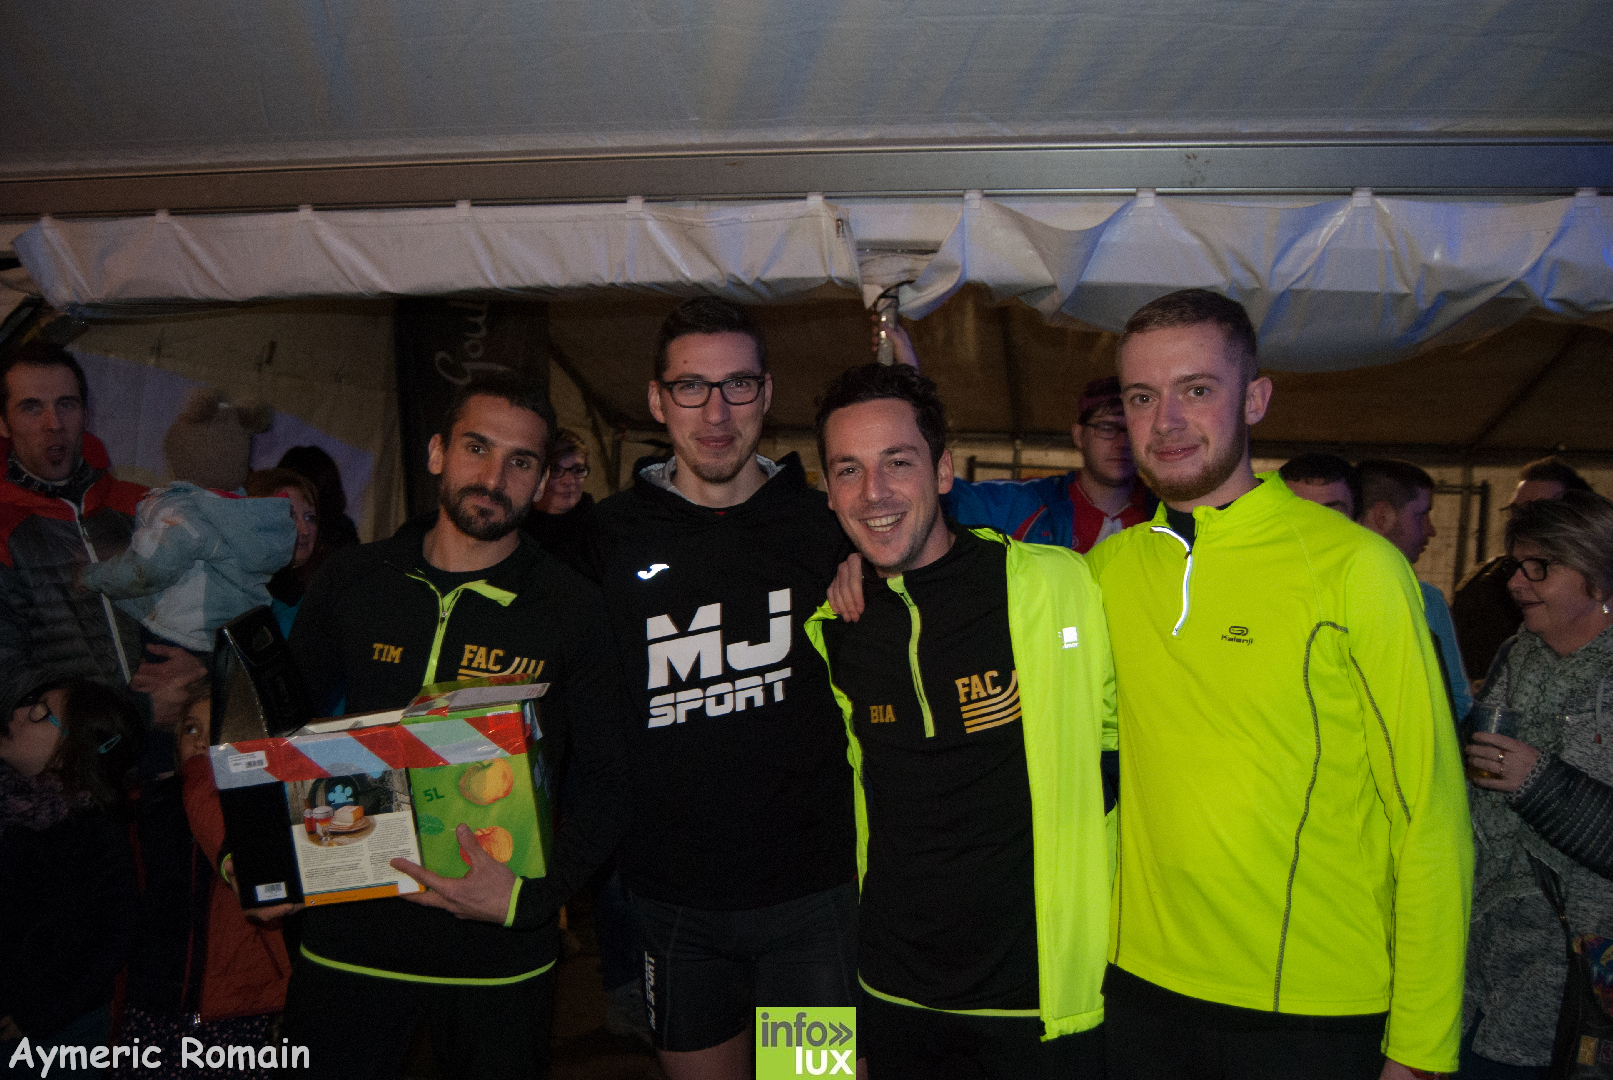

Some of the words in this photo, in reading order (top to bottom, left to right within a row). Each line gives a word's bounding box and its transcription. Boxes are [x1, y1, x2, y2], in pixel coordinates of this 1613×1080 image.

[646, 587, 793, 690] MJ
[372, 643, 404, 664] TIM
[460, 644, 505, 672] FAC
[647, 667, 793, 729] SPORT
[954, 670, 1002, 704] FAC
[869, 704, 897, 724] BIA
[423, 787, 445, 803] 5L
